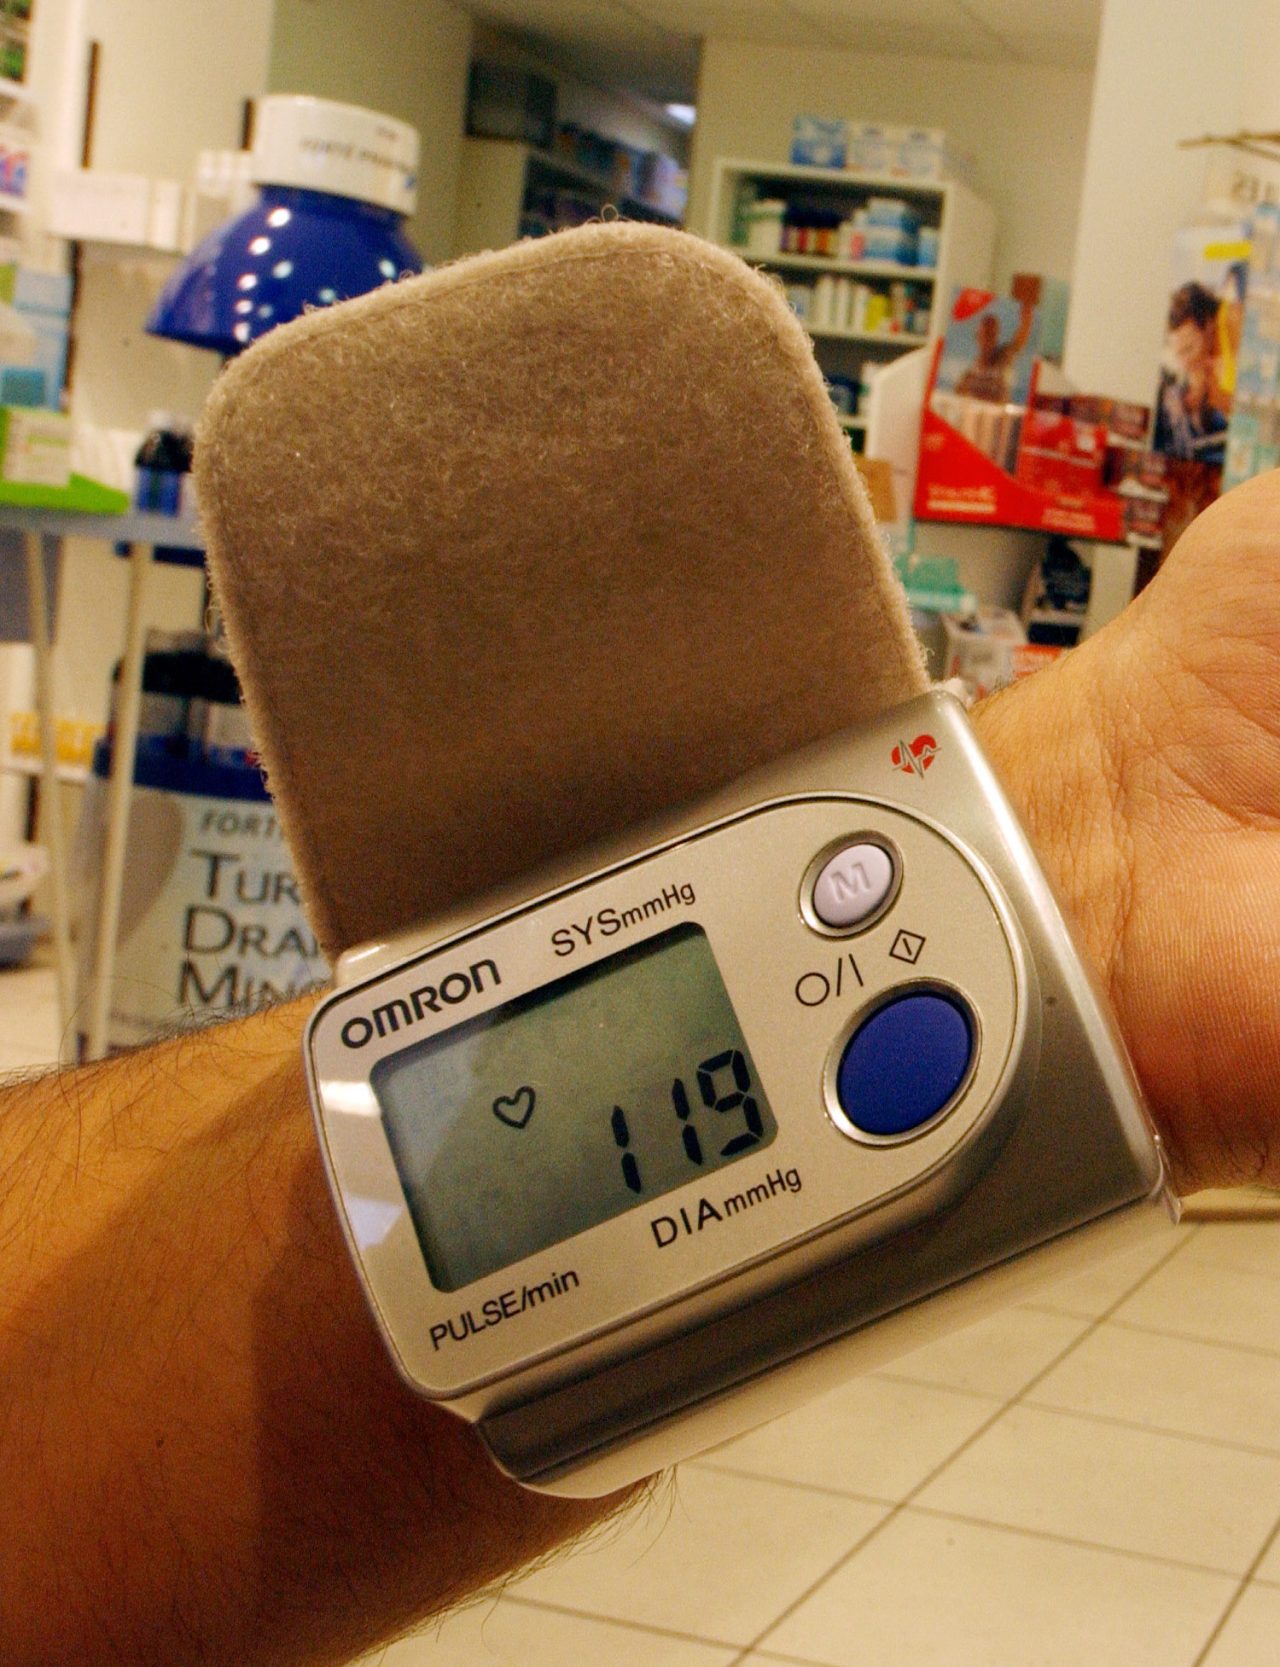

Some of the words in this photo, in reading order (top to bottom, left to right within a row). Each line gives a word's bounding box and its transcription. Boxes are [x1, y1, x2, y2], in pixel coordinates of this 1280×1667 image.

[190, 848, 300, 905] TUR
[830, 860, 872, 904] M
[340, 957, 502, 1051] OMRON
[610, 1048, 764, 1194] 119
[429, 1266, 580, 1352] PULSE/min
